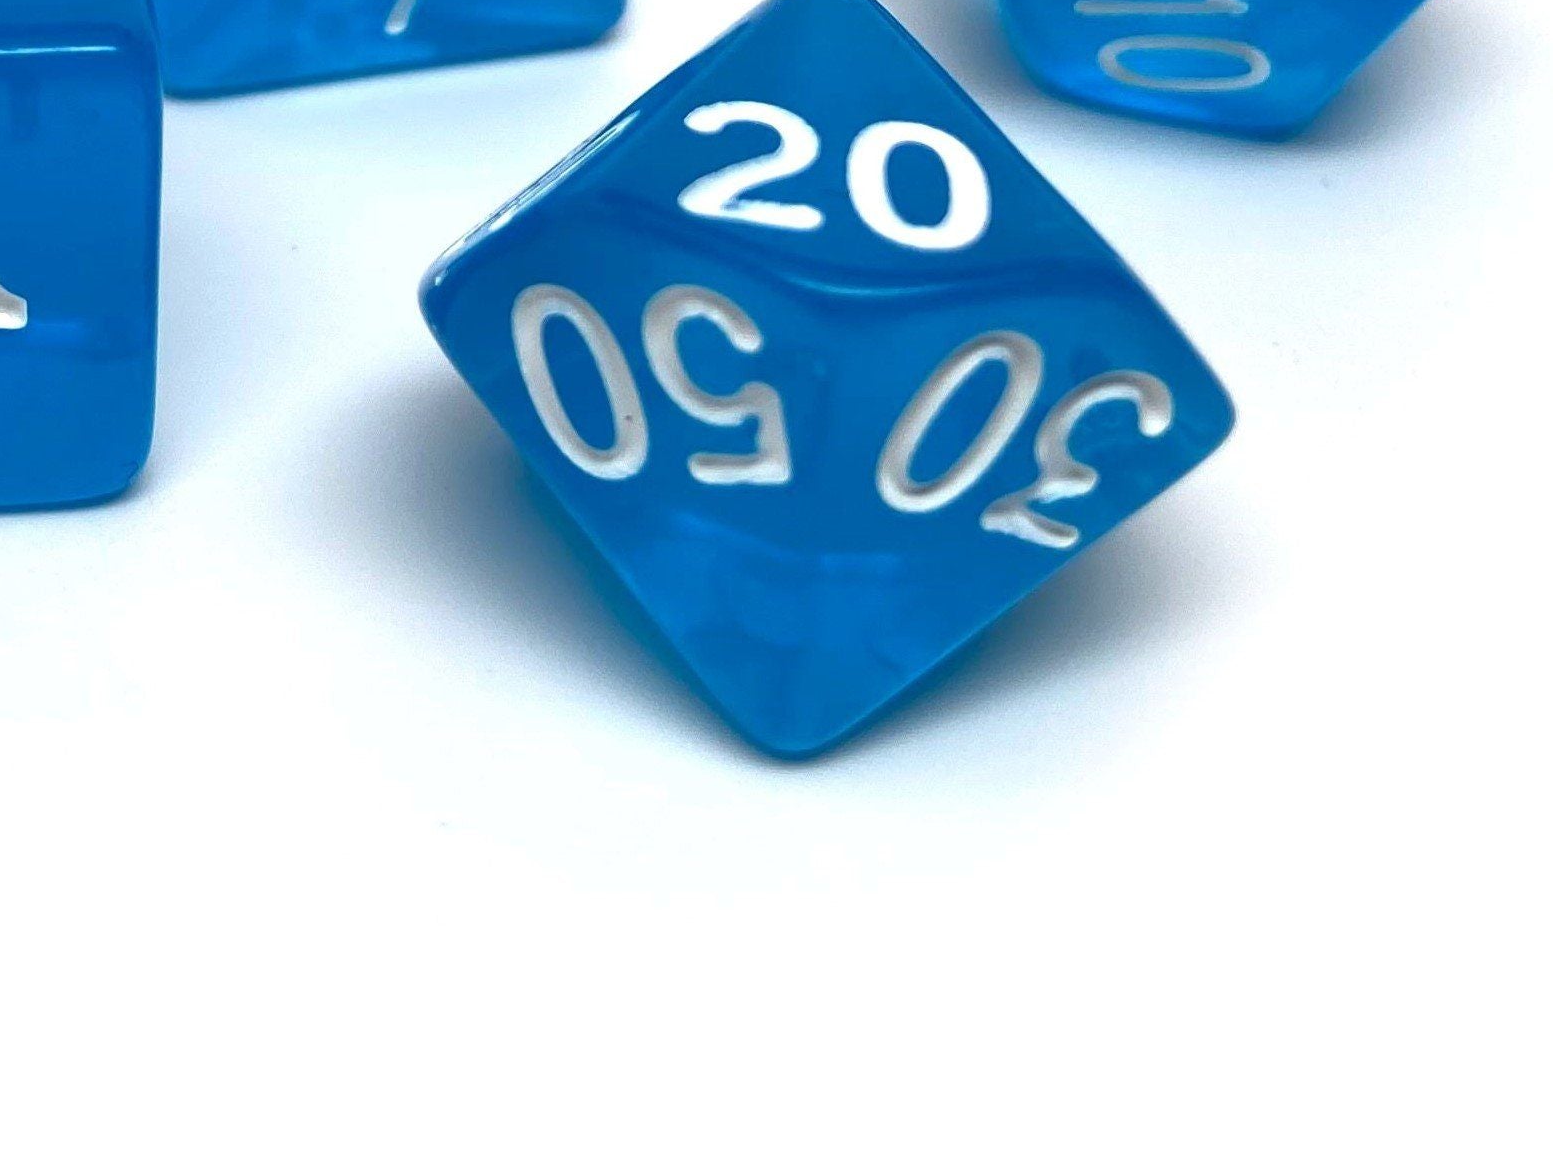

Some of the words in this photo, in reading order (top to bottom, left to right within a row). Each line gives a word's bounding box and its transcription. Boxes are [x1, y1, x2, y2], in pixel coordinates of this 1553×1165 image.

[677, 100, 992, 252] 20
[511, 282, 792, 484] 50
[876, 329, 1174, 549] 30
